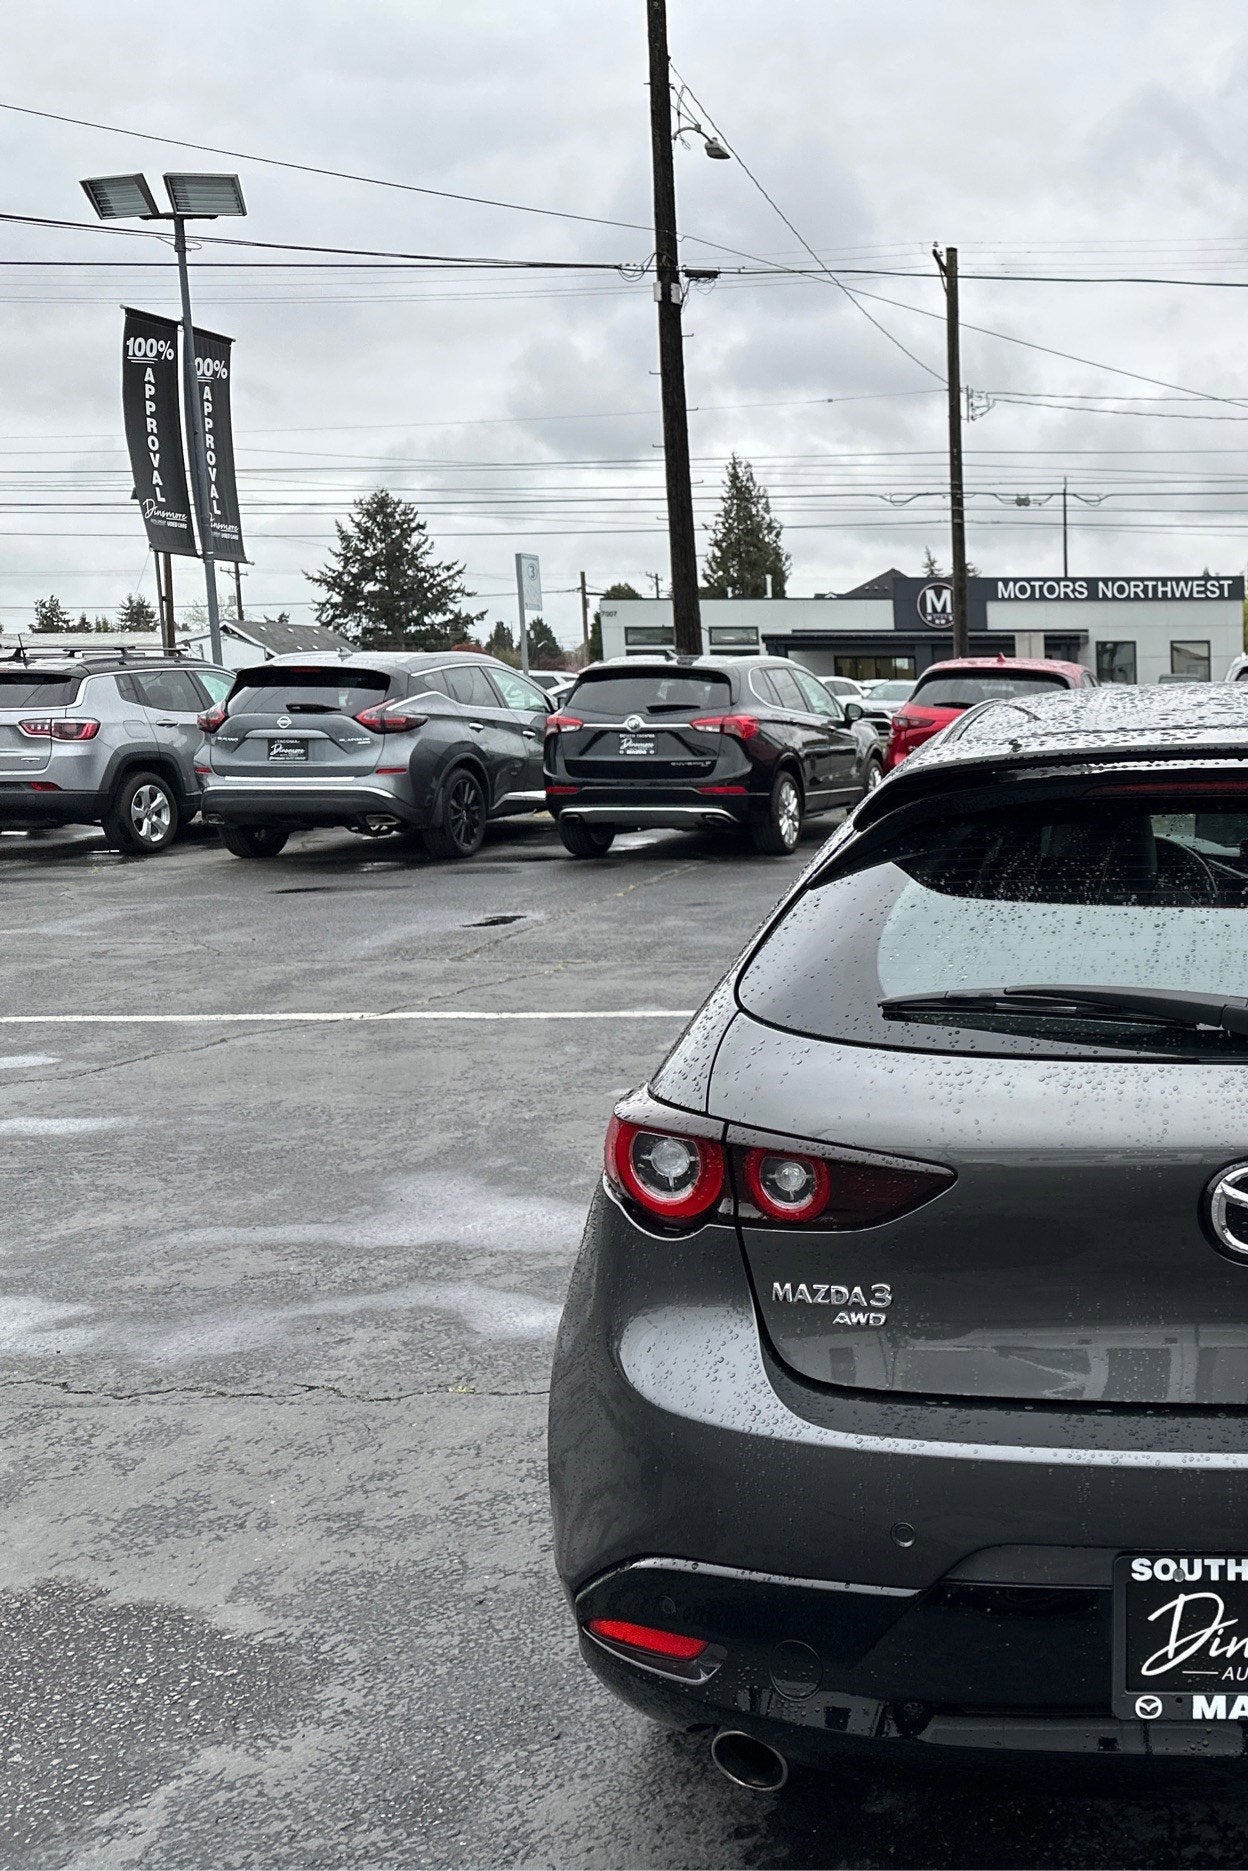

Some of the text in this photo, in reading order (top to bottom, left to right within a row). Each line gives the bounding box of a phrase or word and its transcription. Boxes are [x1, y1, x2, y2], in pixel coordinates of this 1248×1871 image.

[126, 337, 174, 360] 100%
[194, 357, 228, 379] 00%
[144, 367, 166, 503] APPROVAL
[202, 386, 221, 515] APPROVAL
[142, 498, 187, 519] Dinsmore
[997, 580, 1233, 599] MOTORS NORTHWEST
[925, 589, 953, 614] M
[832, 1311, 887, 1327] AWD
